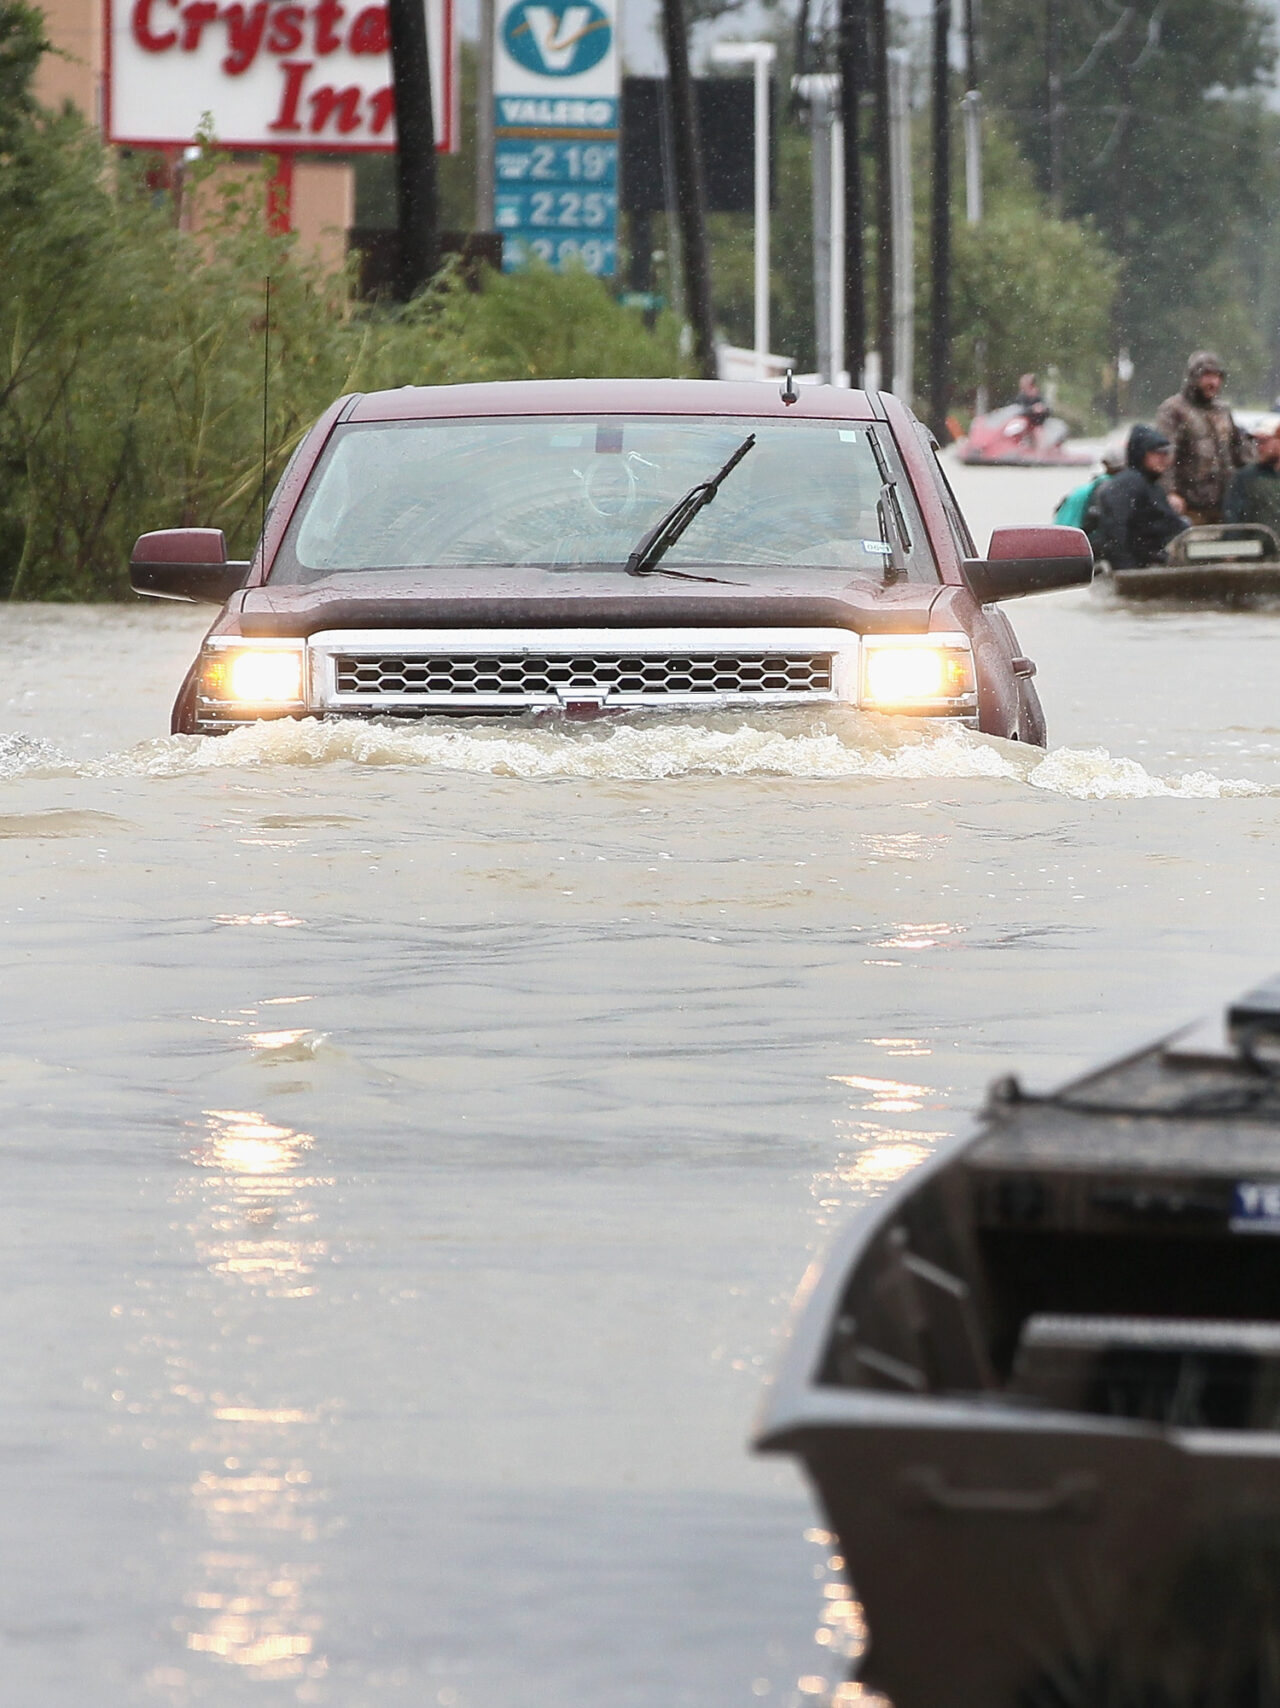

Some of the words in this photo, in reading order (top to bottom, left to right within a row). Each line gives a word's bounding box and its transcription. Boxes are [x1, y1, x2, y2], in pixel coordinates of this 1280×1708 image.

[131, 0, 391, 76] Crysta
[522, 5, 591, 70] V
[501, 99, 615, 125] VALERO
